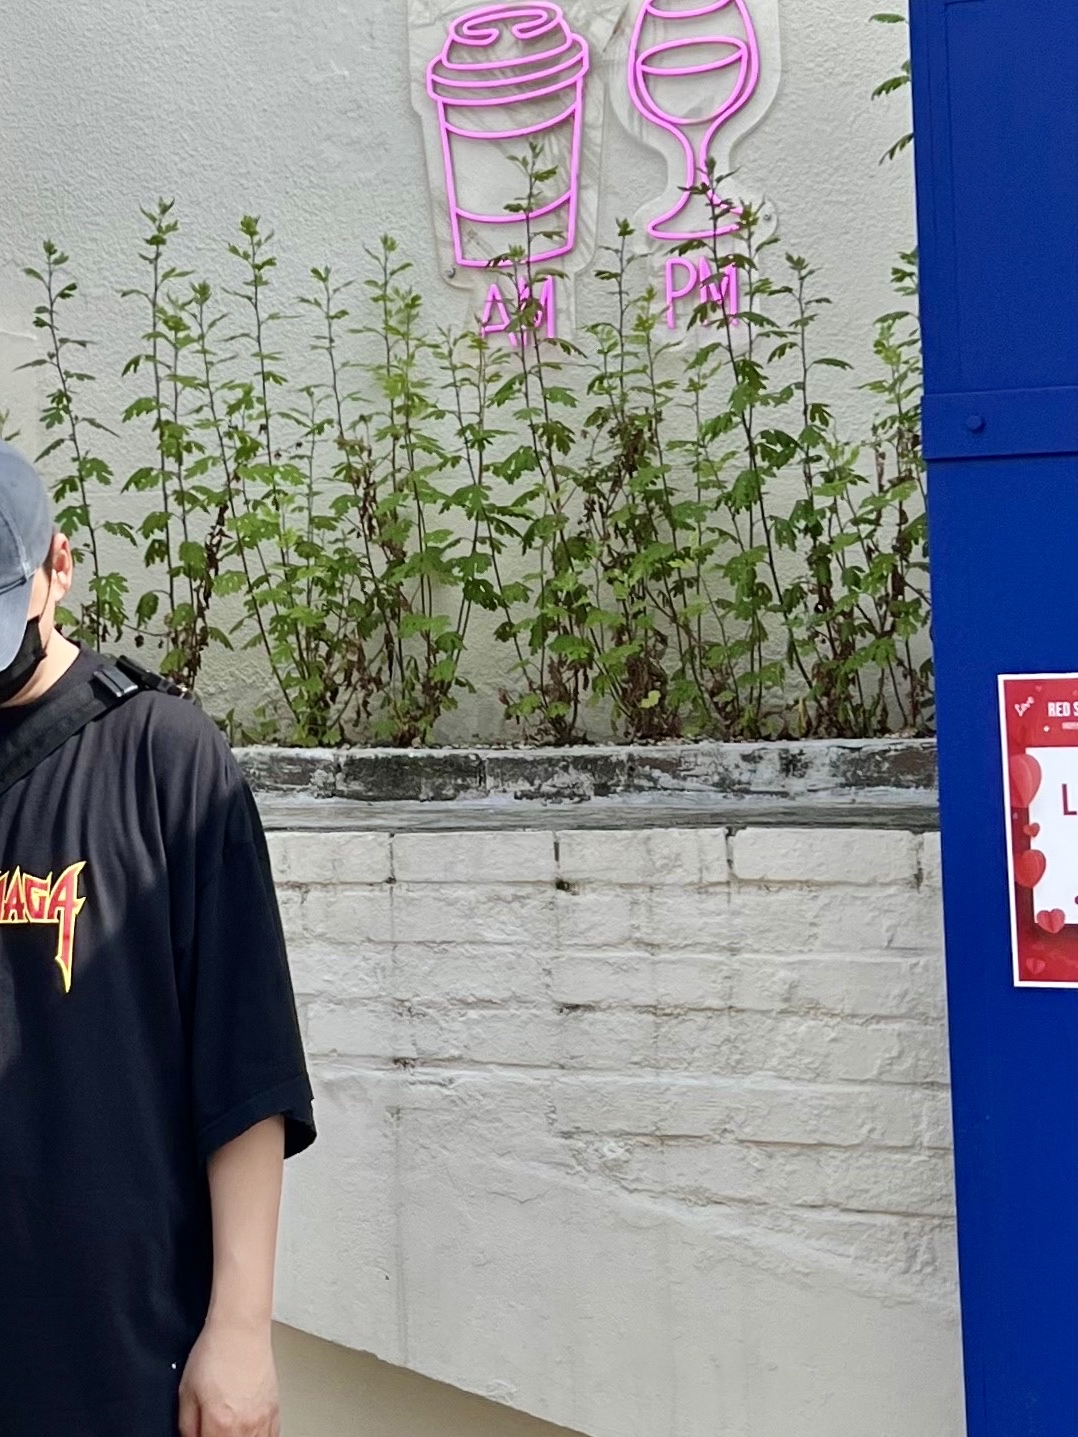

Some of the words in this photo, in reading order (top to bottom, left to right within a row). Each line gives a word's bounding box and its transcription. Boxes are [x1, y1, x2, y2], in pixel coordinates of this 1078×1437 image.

[480, 274, 556, 348] AM
[666, 256, 740, 328] PM
[1047, 701, 1071, 717] RED
